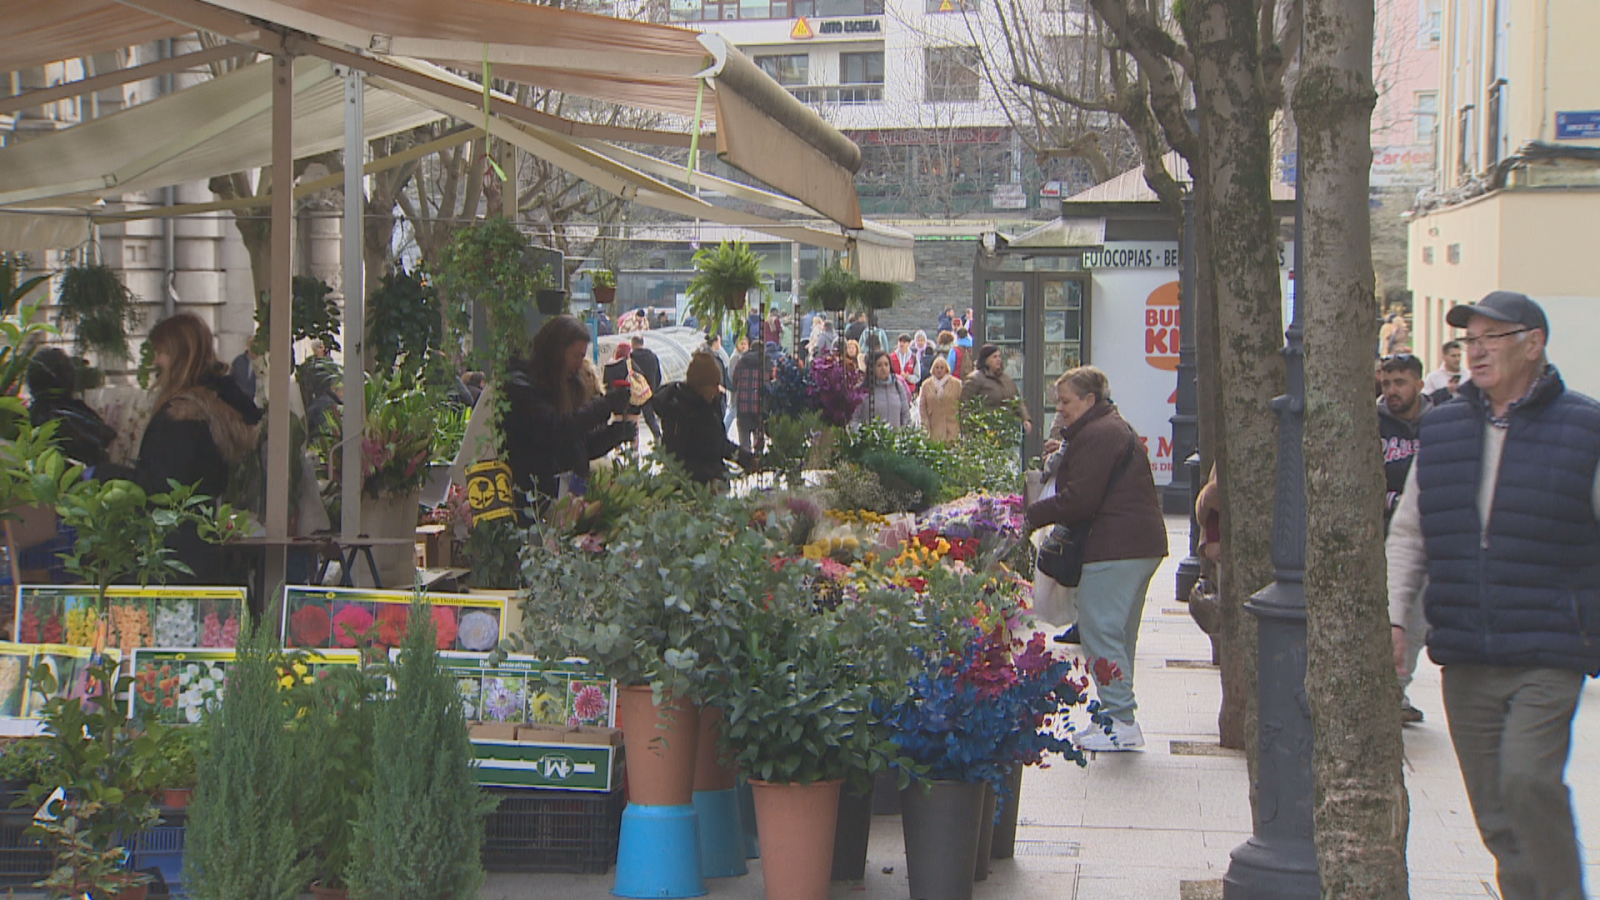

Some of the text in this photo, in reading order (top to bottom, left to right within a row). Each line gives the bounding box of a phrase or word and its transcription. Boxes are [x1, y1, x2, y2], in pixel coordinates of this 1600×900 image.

[819, 19, 881, 34] AUTO ESCUELA
[1083, 249, 1177, 267] FOTOCOPIAS BE
[1145, 327, 1180, 354] KI
